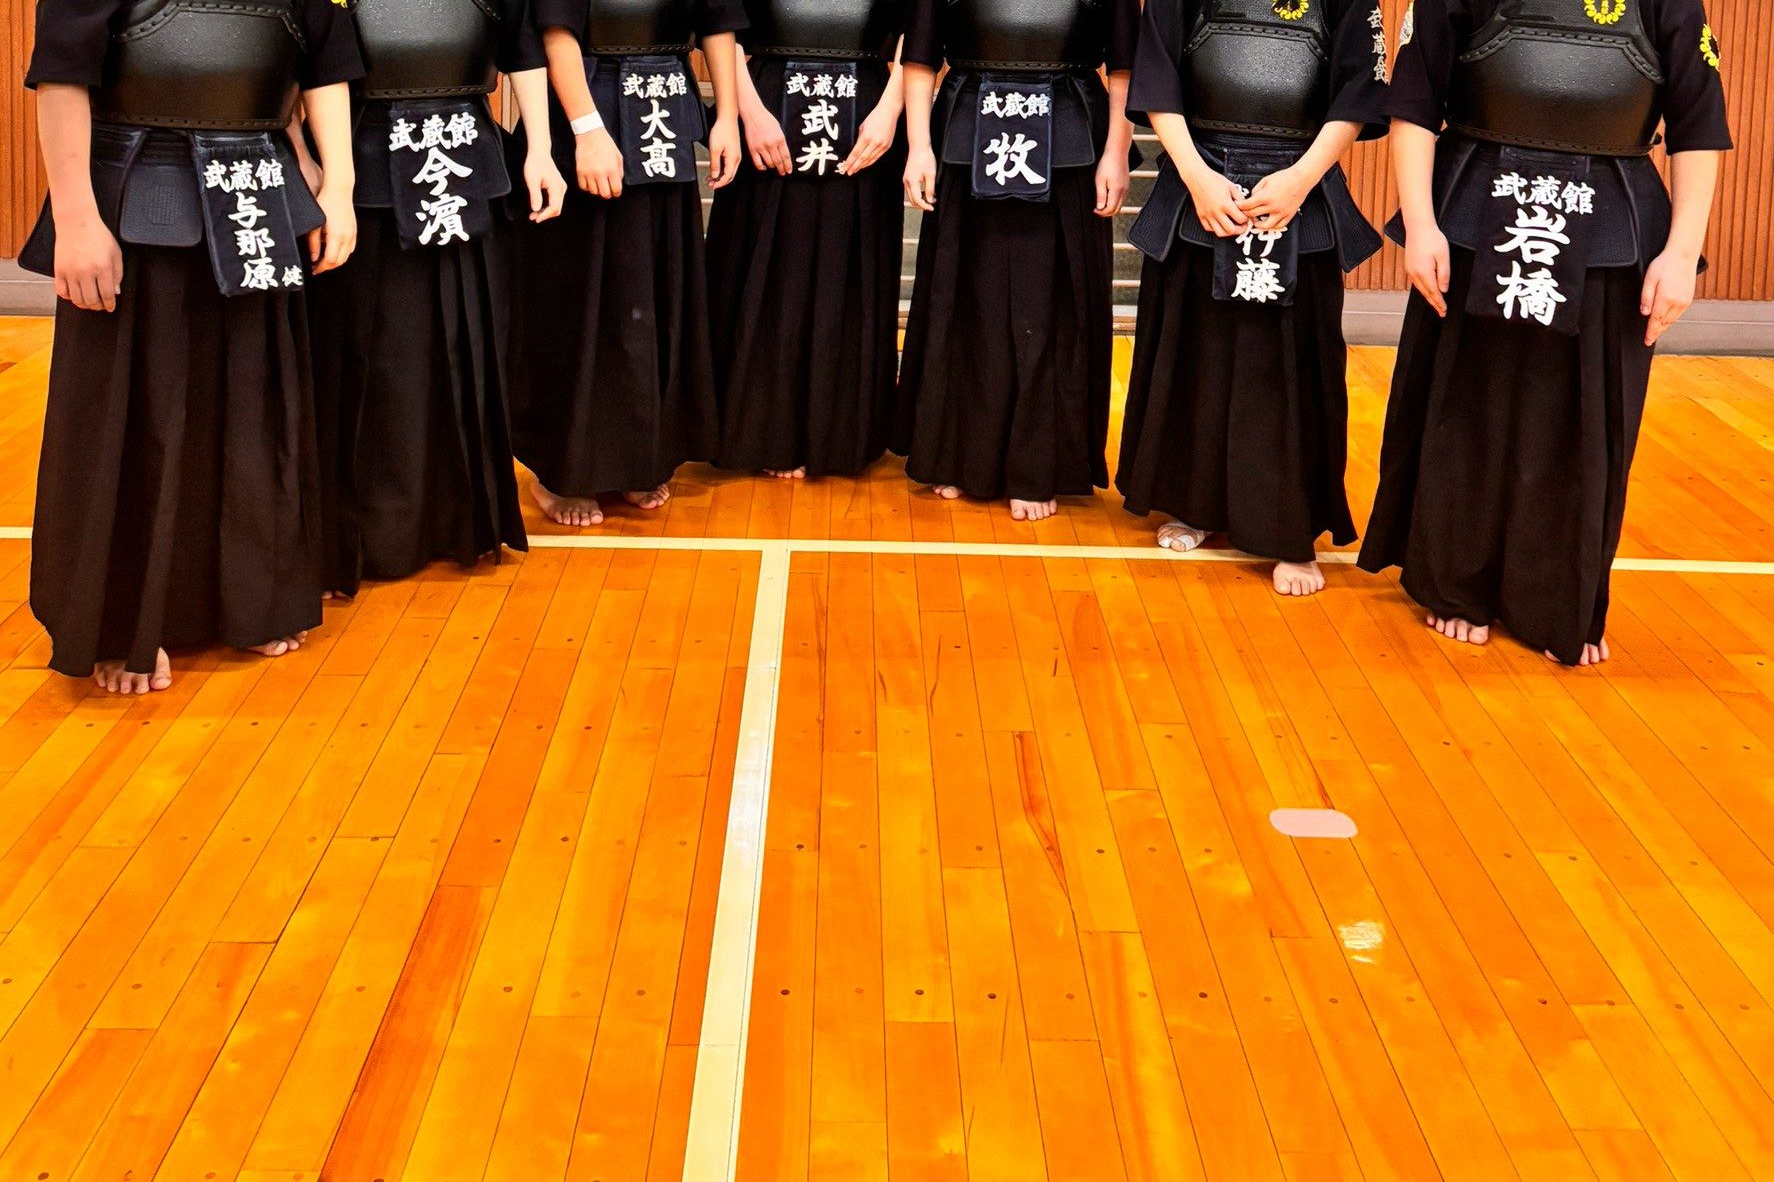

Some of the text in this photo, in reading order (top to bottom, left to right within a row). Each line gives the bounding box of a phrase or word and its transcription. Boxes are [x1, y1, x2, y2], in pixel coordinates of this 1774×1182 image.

[622, 72, 687, 99] 武蔵館
[786, 72, 858, 99] 武蔵館
[981, 91, 1051, 119] 武蔵館
[388, 112, 478, 152] 武蔵館
[795, 99, 839, 175] 武井
[203, 158, 285, 192] 武蔵館
[982, 132, 1047, 186] 牧
[1491, 171, 1596, 215] 武蔵館
[227, 191, 278, 290] 与那原
[1493, 205, 1571, 326] 岩橋
